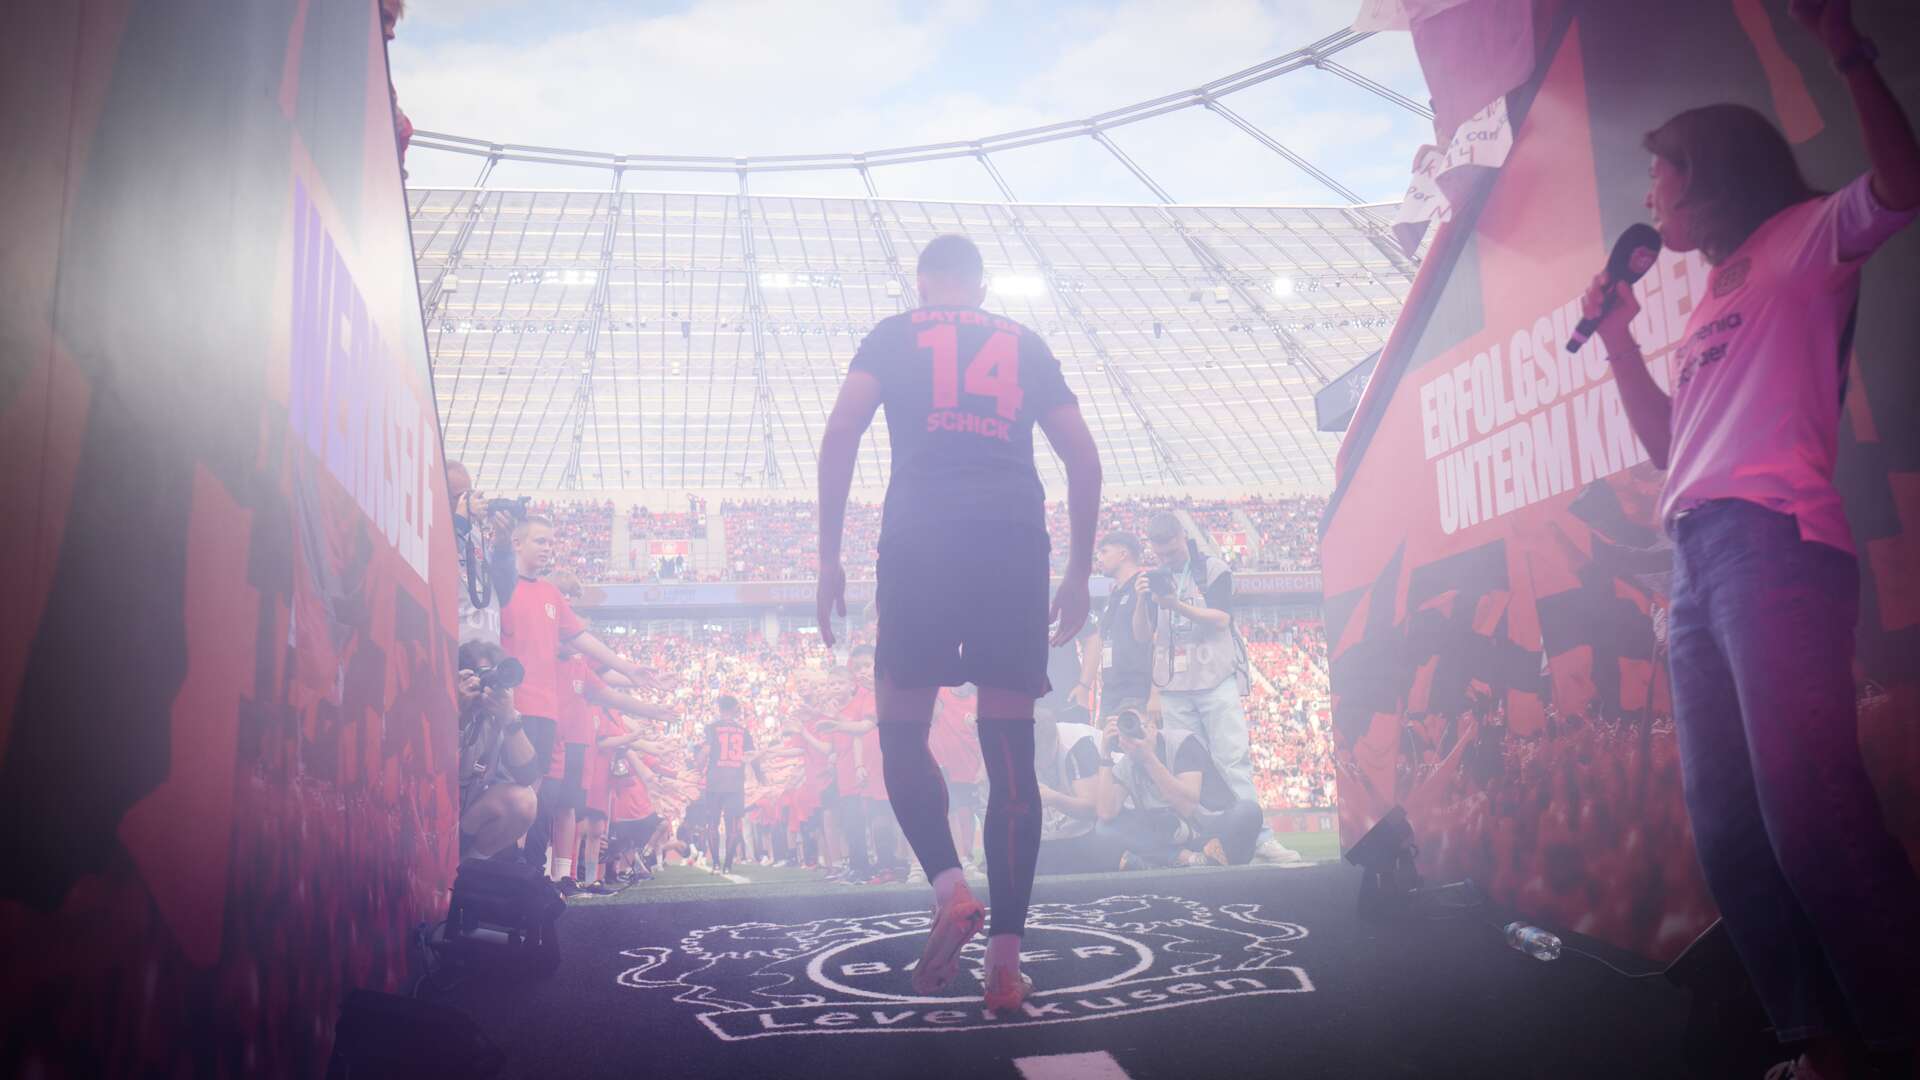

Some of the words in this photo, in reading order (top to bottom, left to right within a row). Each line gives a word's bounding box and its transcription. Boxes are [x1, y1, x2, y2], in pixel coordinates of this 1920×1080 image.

[911, 309, 988, 326] BAYER
[1420, 247, 1713, 461] ERFOLGSHUGE
[917, 323, 1025, 421] 14
[926, 410, 1010, 441] SCHICK
[1436, 402, 1575, 535] UNTERM
[719, 736, 744, 760] 13
[841, 945, 1123, 977] BER
